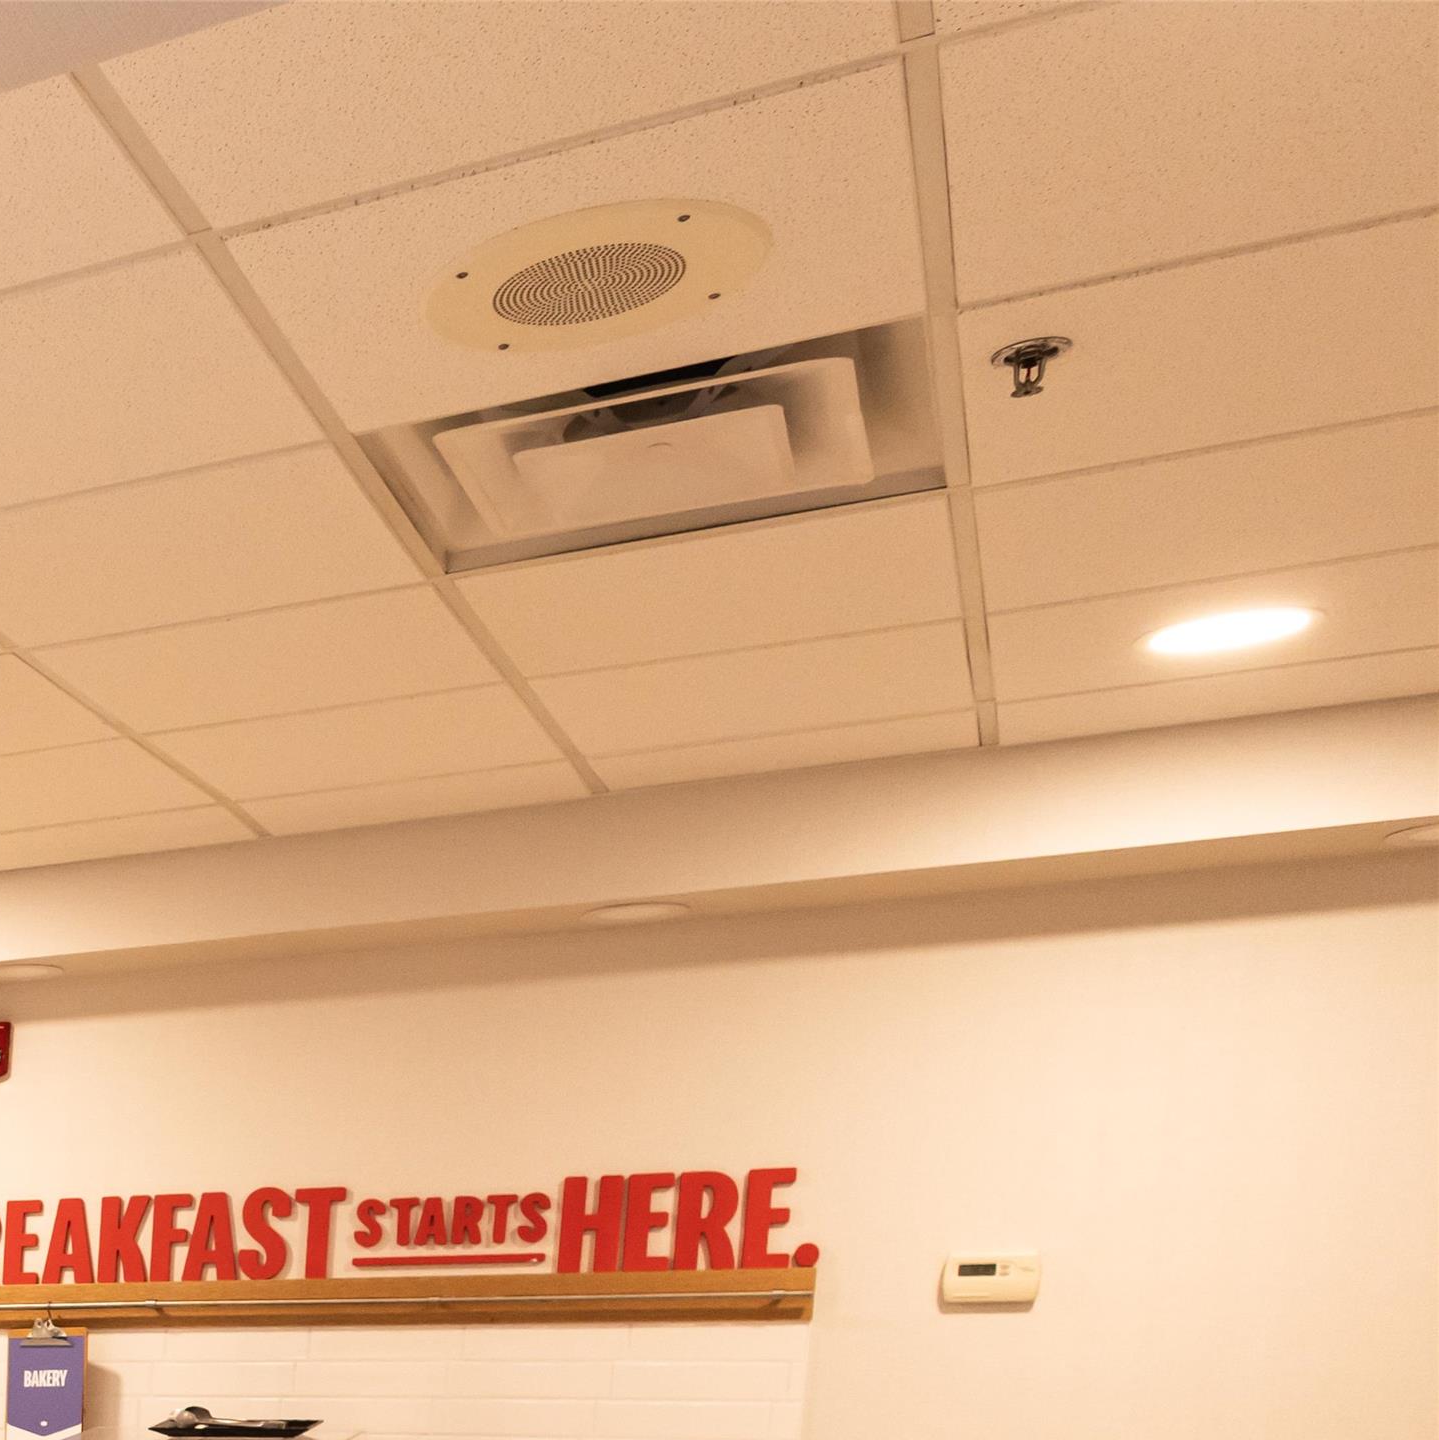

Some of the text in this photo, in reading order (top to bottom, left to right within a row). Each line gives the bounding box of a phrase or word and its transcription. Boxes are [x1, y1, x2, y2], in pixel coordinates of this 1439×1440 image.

[353, 1191, 551, 1250] STARTS
[556, 1167, 820, 1274] HERE.
[23, 1369, 68, 1388] BAKERY
